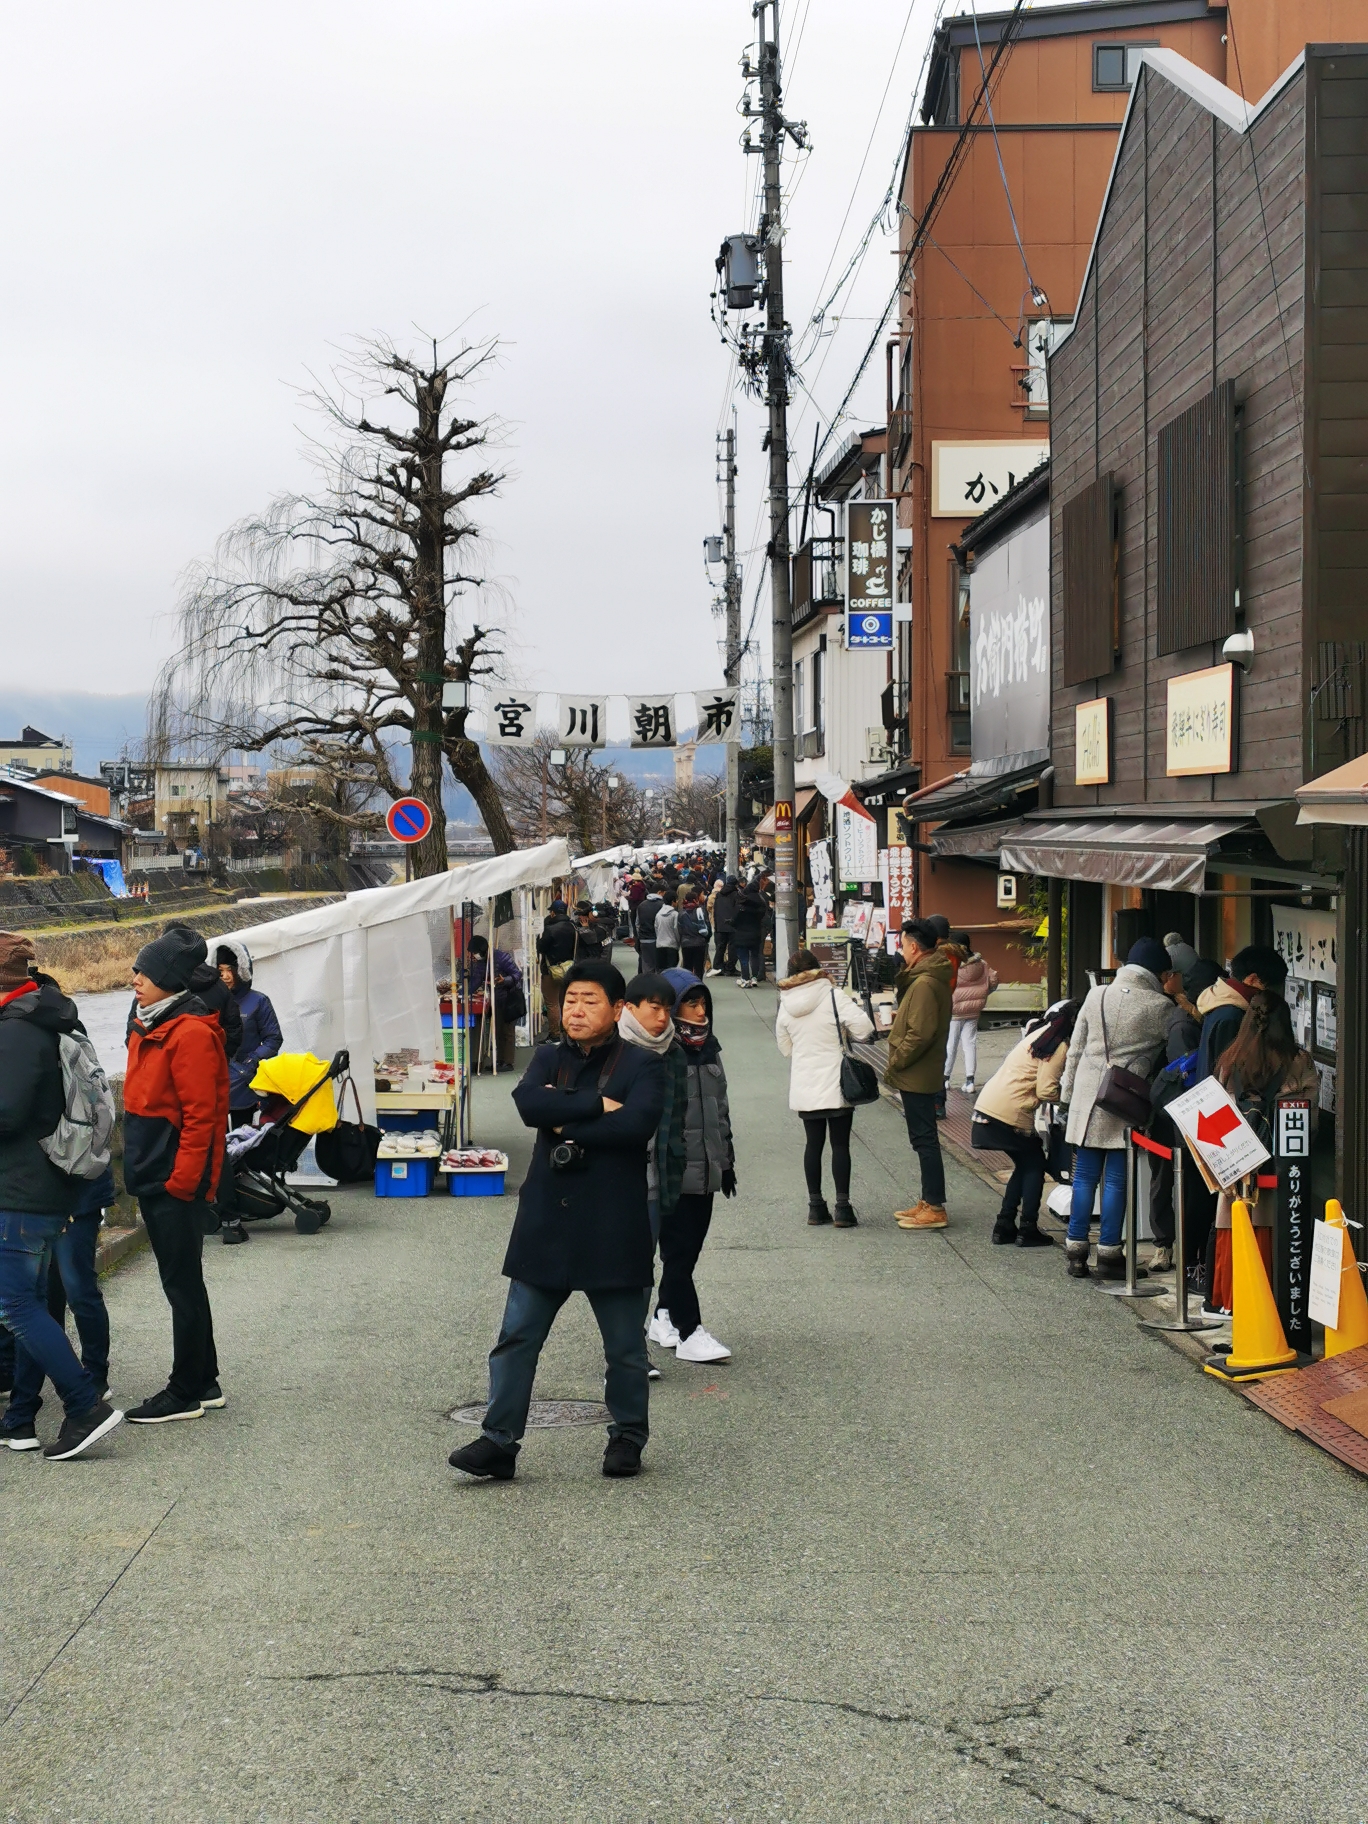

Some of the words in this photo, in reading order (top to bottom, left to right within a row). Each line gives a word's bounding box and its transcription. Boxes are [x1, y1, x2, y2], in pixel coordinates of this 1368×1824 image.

[870, 507, 887, 558] かじ橋
[852, 541, 869, 575] 珈琲
[850, 598, 892, 608] COFFEE
[1285, 1111, 1304, 1153] 出口
[1288, 1165, 1302, 1330] ありがとうございました
